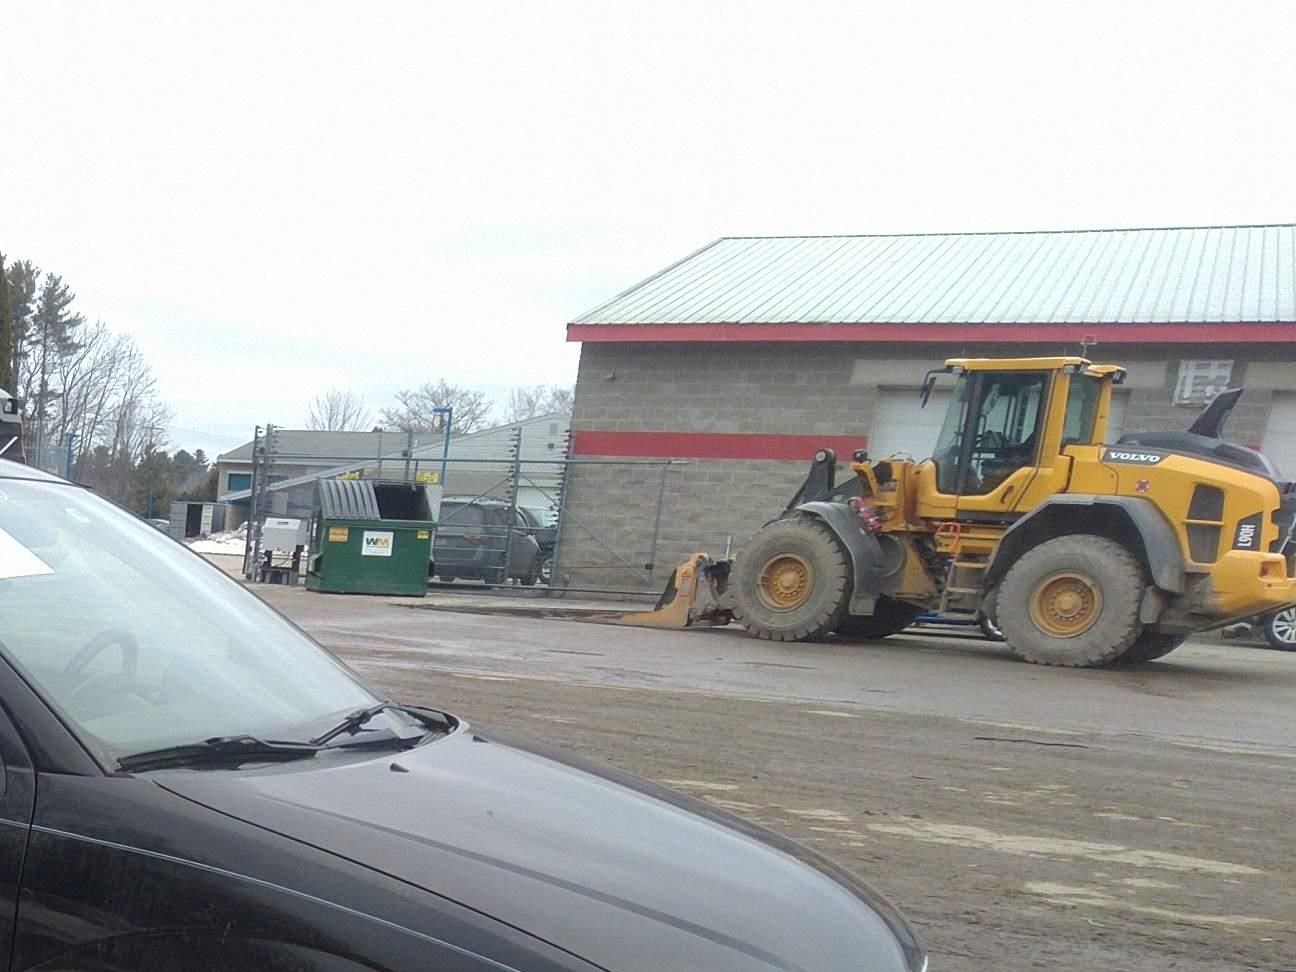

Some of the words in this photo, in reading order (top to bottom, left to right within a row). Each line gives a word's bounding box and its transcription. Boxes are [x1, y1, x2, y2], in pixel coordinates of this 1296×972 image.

[1109, 451, 1161, 463] VOLVO
[365, 537, 390, 546] WM
[1236, 524, 1256, 547] L90H
